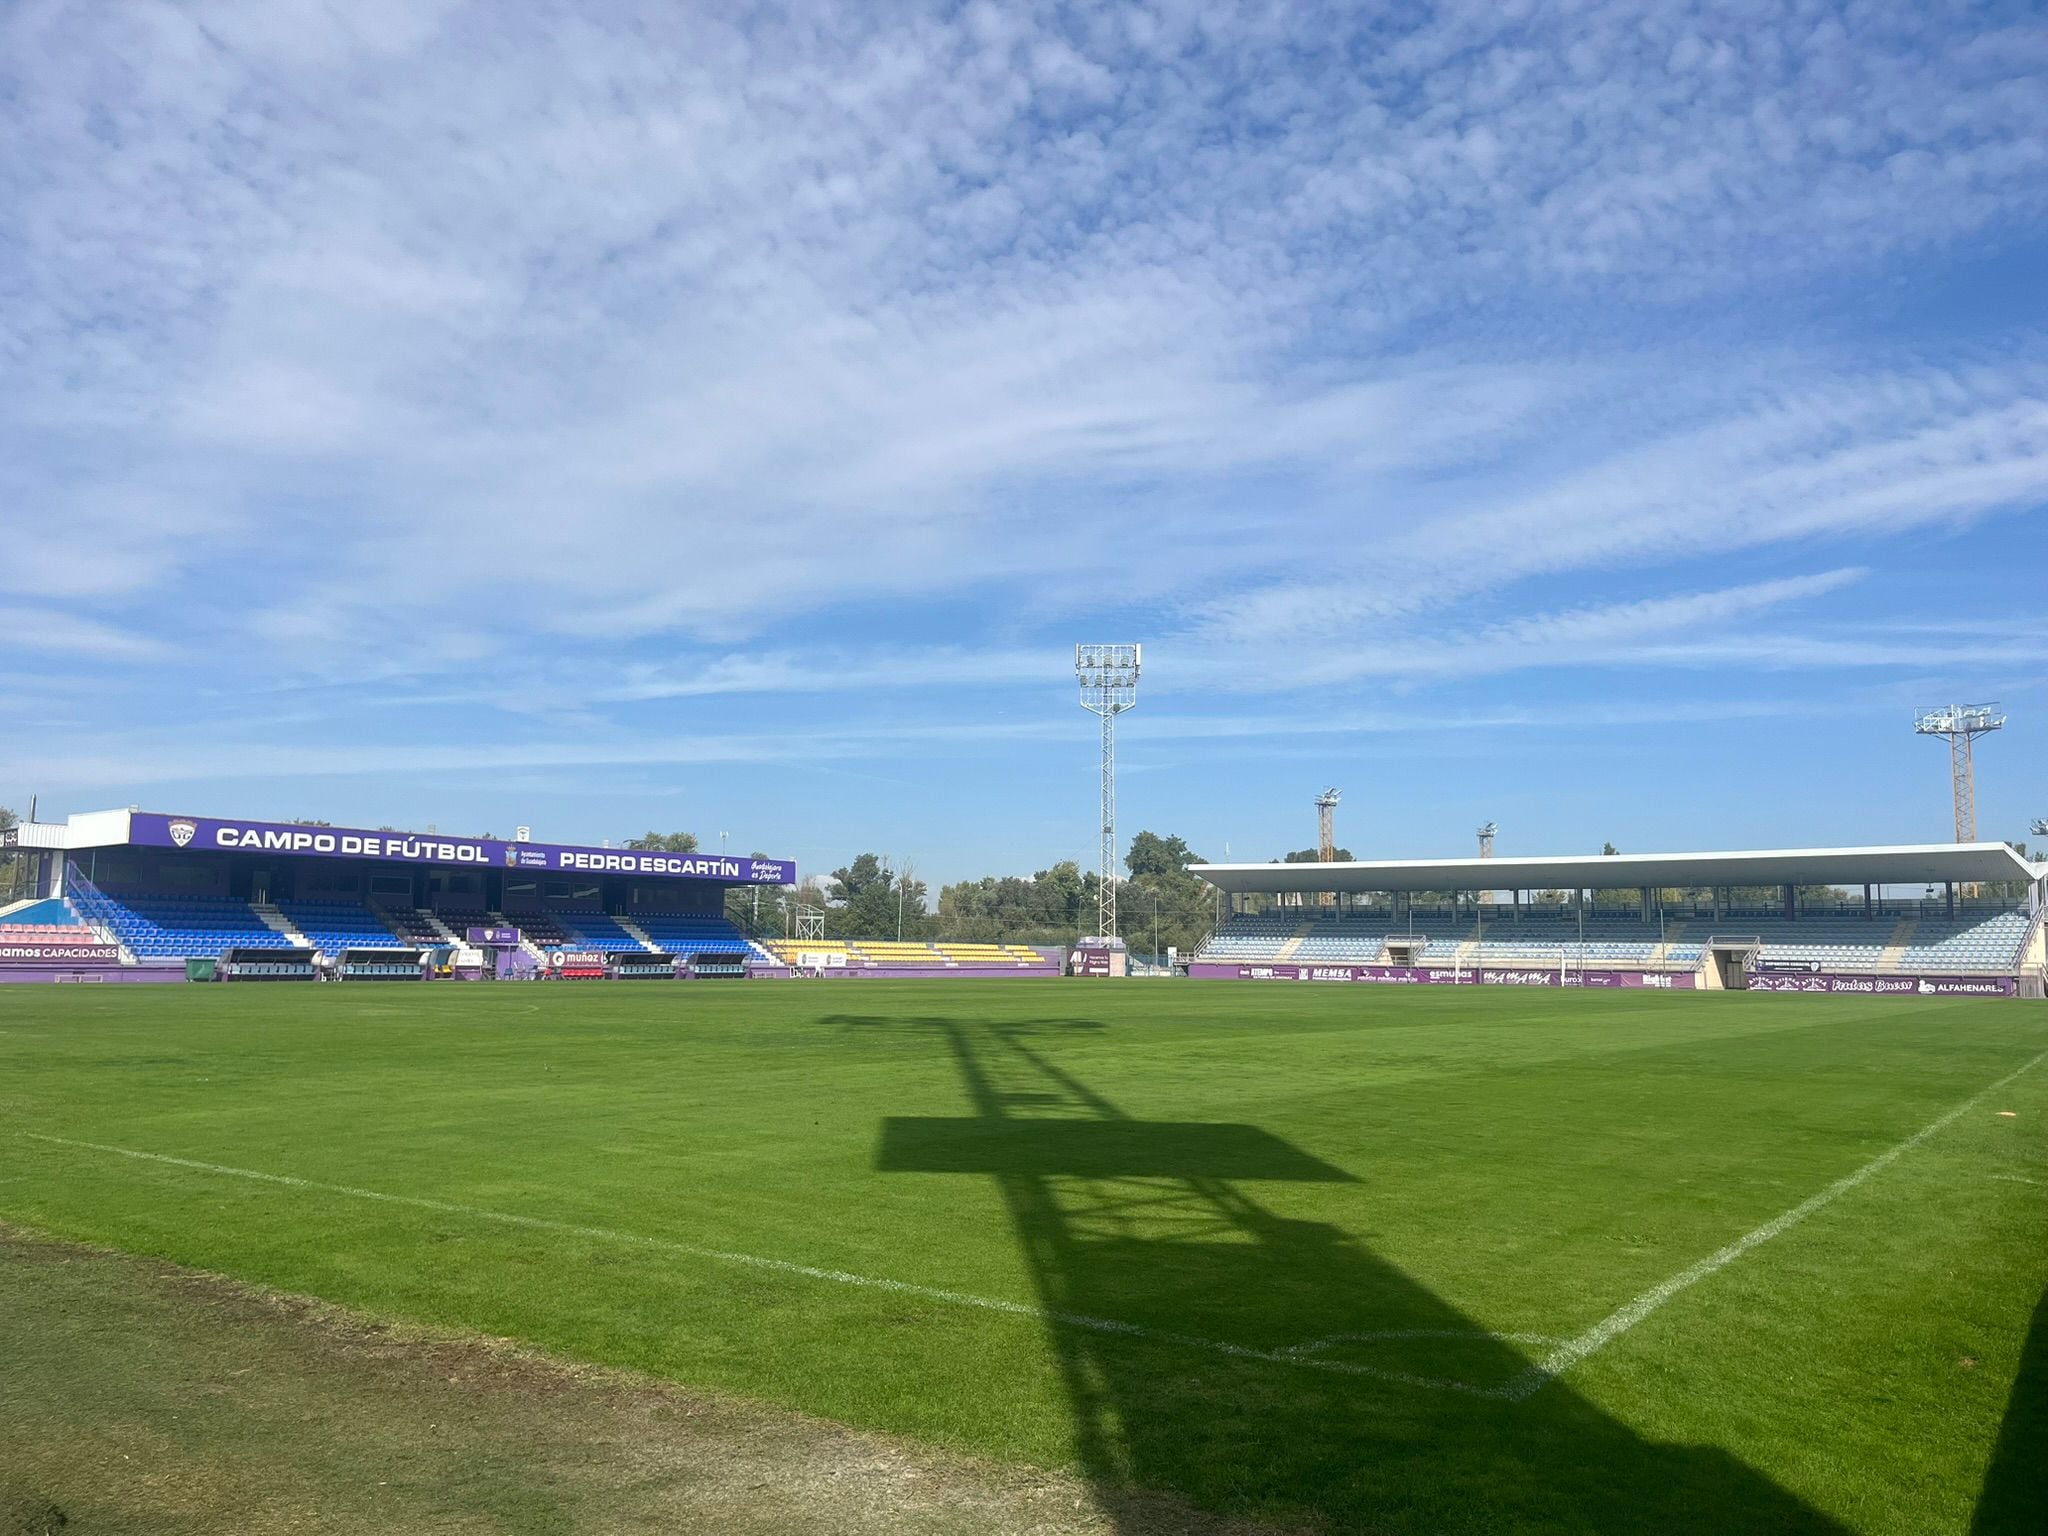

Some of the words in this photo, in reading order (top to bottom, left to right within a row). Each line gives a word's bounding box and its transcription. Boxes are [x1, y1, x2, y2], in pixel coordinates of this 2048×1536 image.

[216, 827, 336, 852] CAMPO
[341, 836, 381, 856] DE
[386, 836, 490, 863] FÚTBOL
[559, 852, 637, 871] PEDRO
[640, 858, 739, 877] ESCARTÍN
[0, 948, 41, 958] amos
[42, 947, 118, 958] CAPACIDADES
[567, 951, 599, 963] muñoz
[1312, 968, 1352, 978] MEMSA
[1937, 983, 2004, 993] ALFAHENARES
